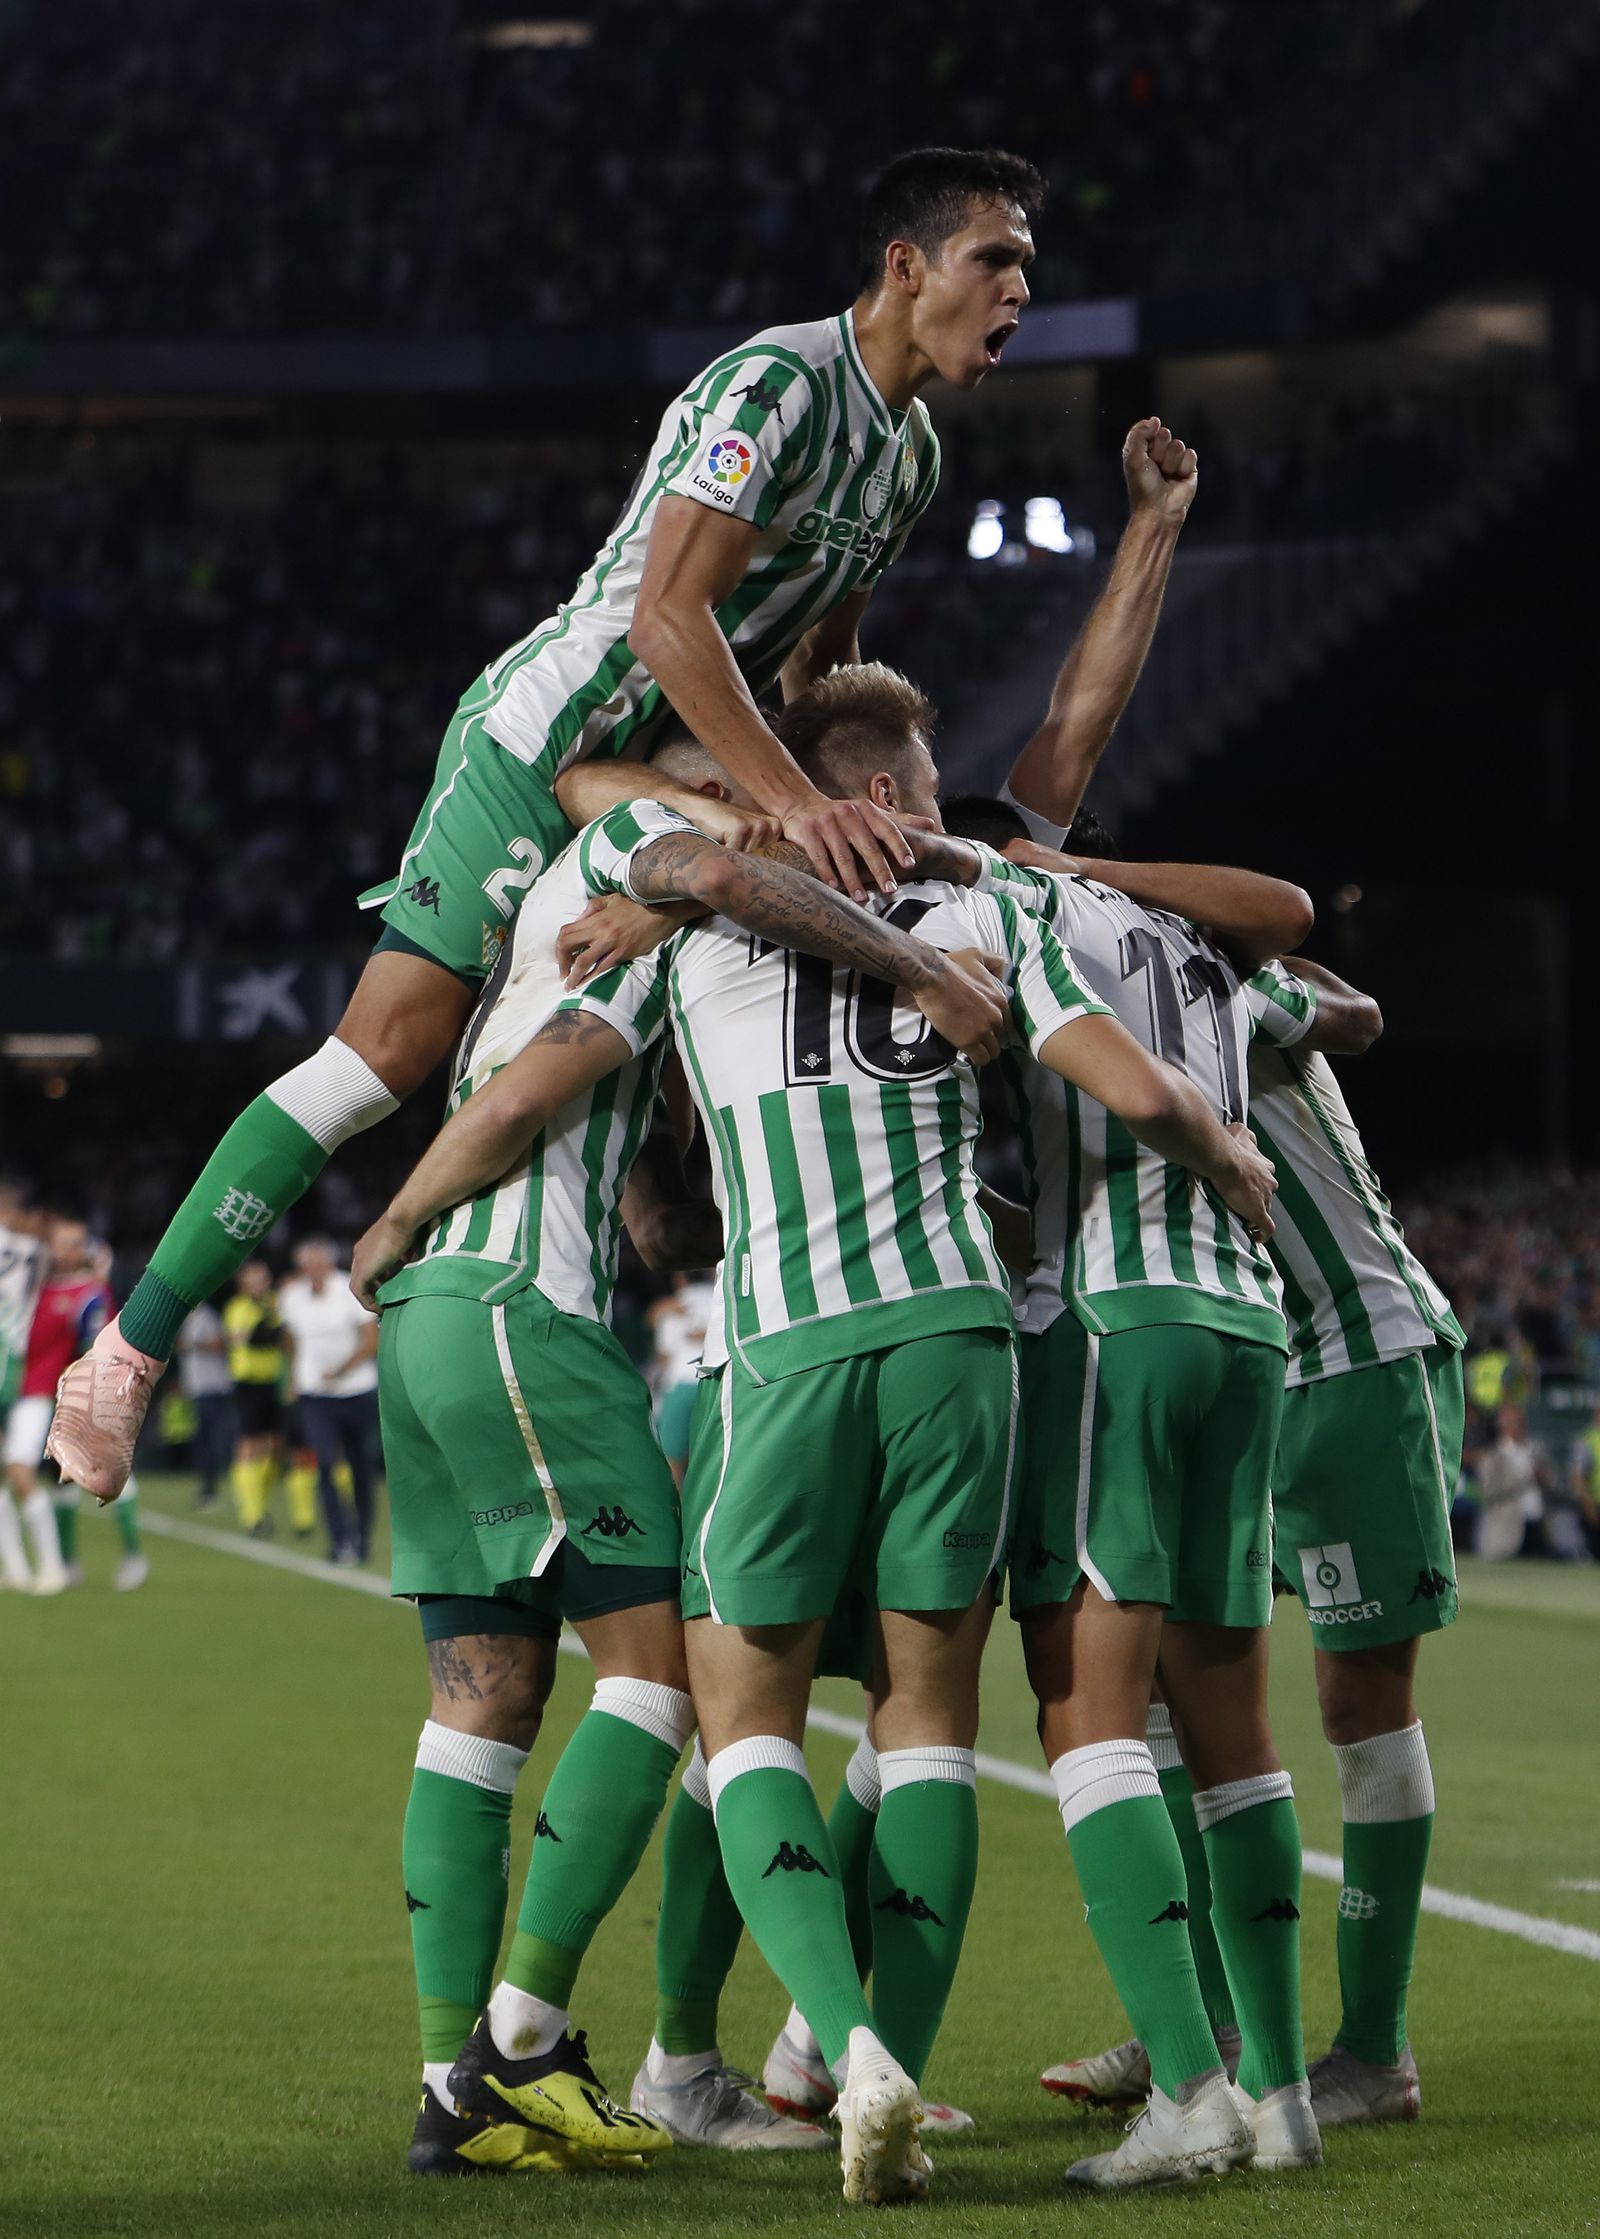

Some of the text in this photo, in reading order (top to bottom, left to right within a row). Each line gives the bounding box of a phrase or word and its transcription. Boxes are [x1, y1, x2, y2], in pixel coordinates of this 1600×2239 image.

[692, 474, 734, 505] LaLiga
[1118, 926, 1244, 1124] 11
[943, 1532, 990, 1549] Kappa
